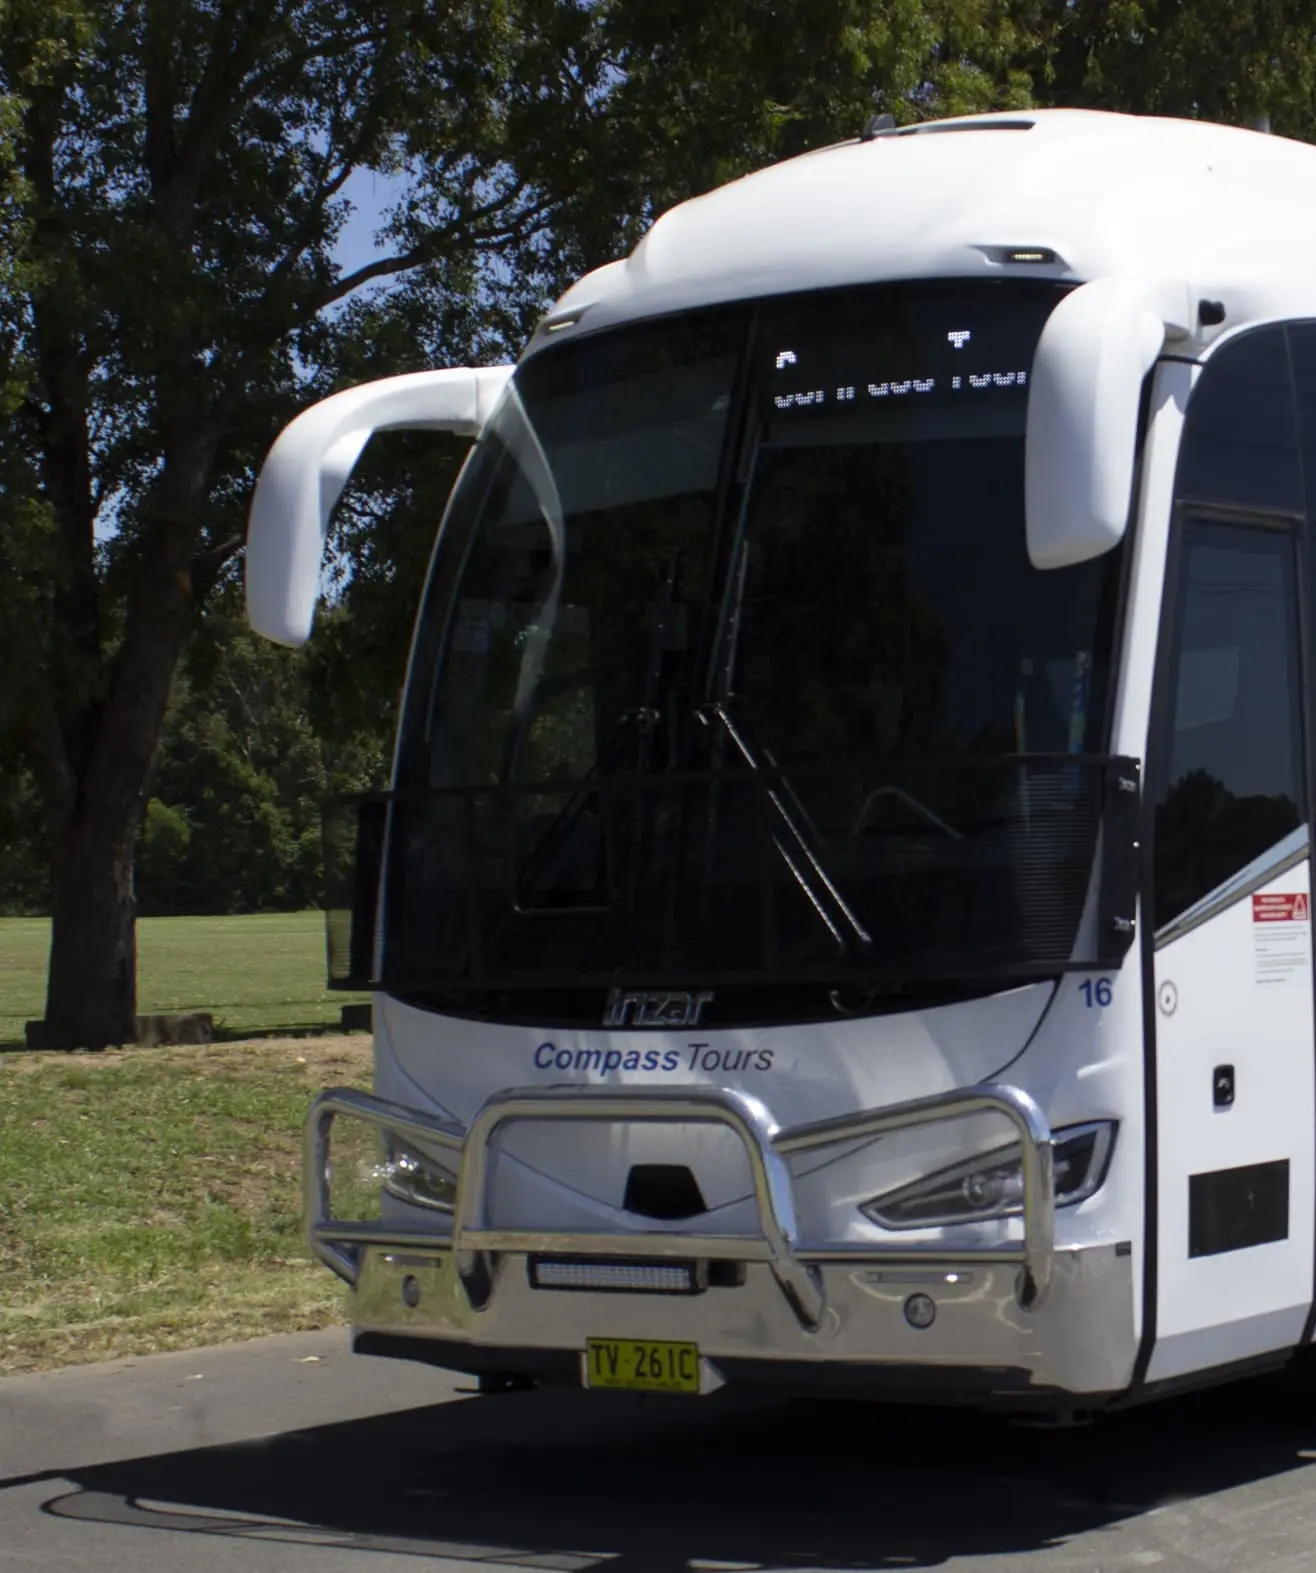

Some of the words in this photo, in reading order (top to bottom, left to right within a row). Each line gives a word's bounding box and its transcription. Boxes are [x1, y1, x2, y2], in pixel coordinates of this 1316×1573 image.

[1078, 978, 1113, 1009] 16
[533, 1042, 680, 1076] Compass
[686, 1044, 774, 1072] Tours
